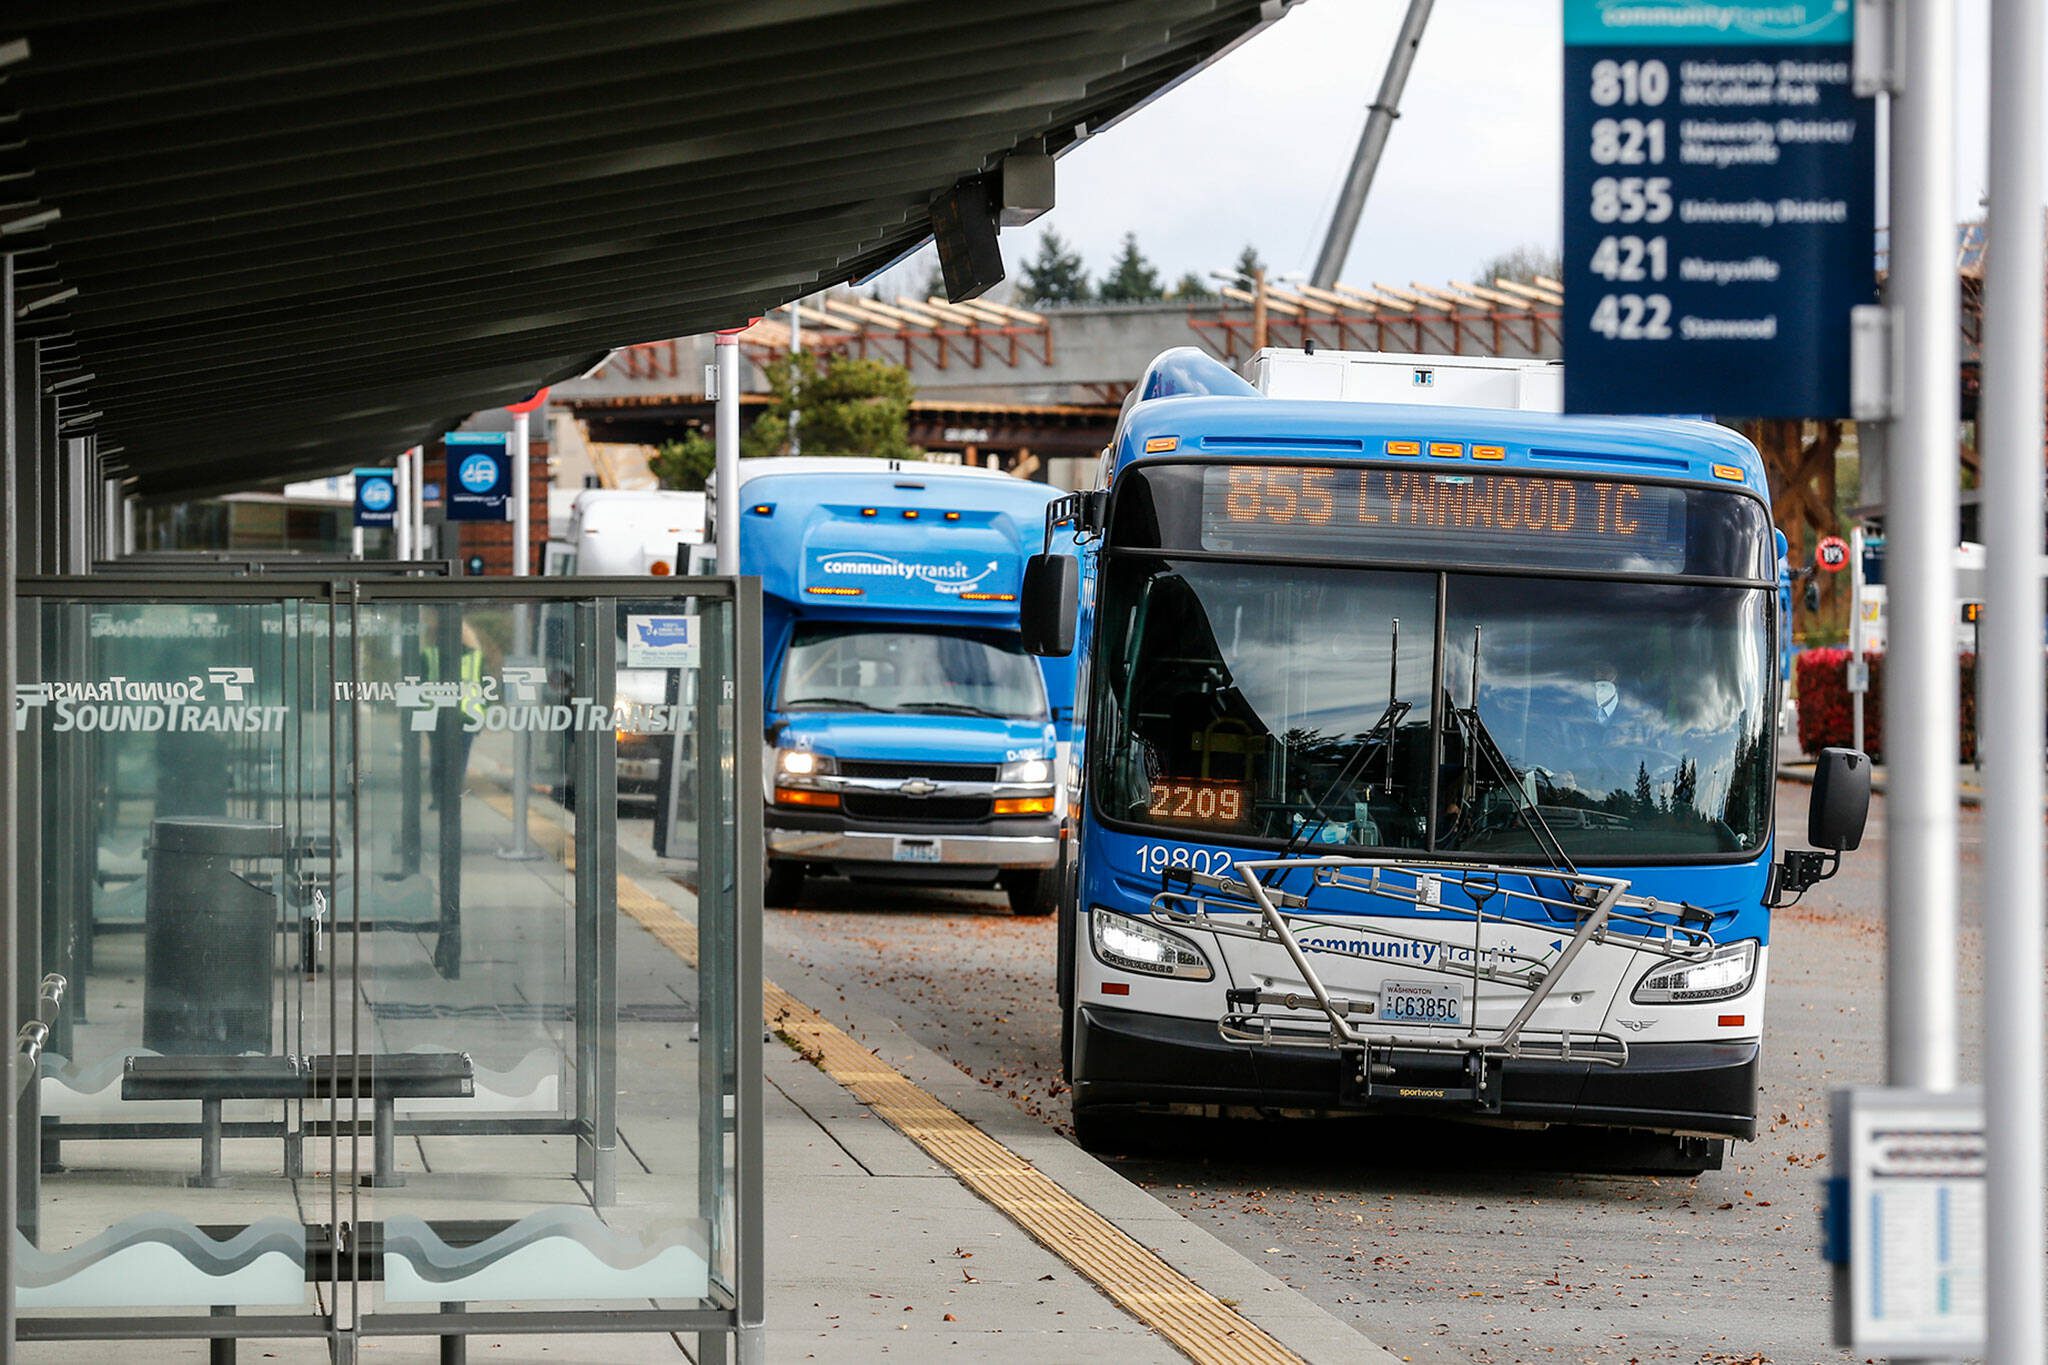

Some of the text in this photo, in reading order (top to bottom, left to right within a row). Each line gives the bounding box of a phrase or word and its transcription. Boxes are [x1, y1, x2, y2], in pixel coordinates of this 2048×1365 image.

[1592, 60, 1669, 106] 810
[1681, 61, 1775, 84] University
[1592, 118, 1666, 165] 821
[1680, 118, 1775, 143] University
[1592, 177, 1847, 227] 855 University District
[1591, 236, 1668, 281] 421
[1591, 294, 1777, 339] 422 Stanwood
[1227, 465, 1640, 534] 855 LYNNWOOD TC
[1149, 785, 1240, 819] 2209
[1136, 844, 1232, 877] 19802
[1386, 986, 1432, 995] WASHINGTON
[1395, 996, 1458, 1019] C6385C
[1399, 1088, 1445, 1098] sportworks
